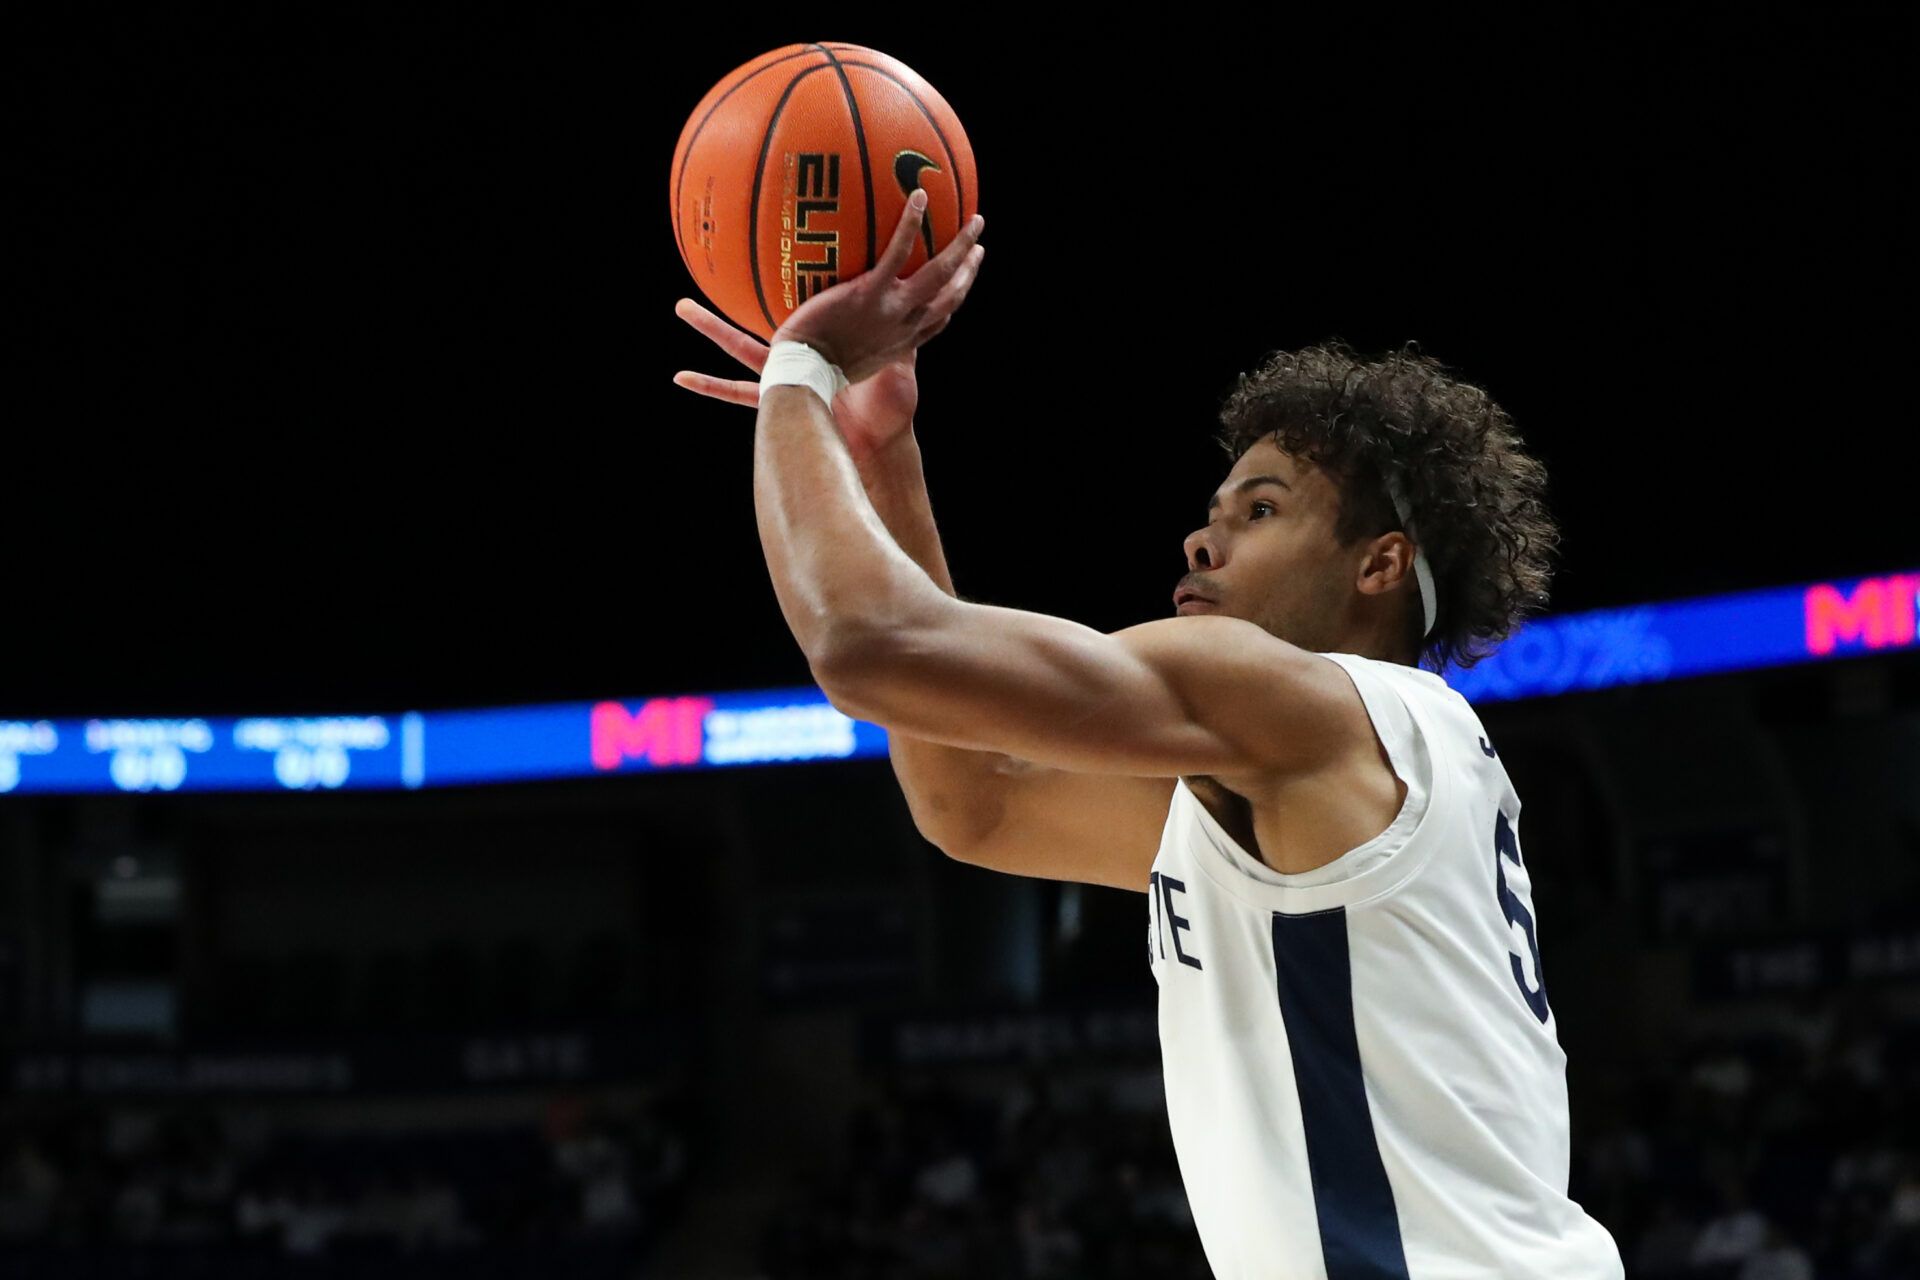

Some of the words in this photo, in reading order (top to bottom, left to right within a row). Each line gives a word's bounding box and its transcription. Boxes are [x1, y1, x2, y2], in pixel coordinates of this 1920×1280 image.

[780, 152, 794, 310] CHAMPIONSHIP
[795, 153, 841, 307] ELITE
[1148, 871, 1203, 971] TE
